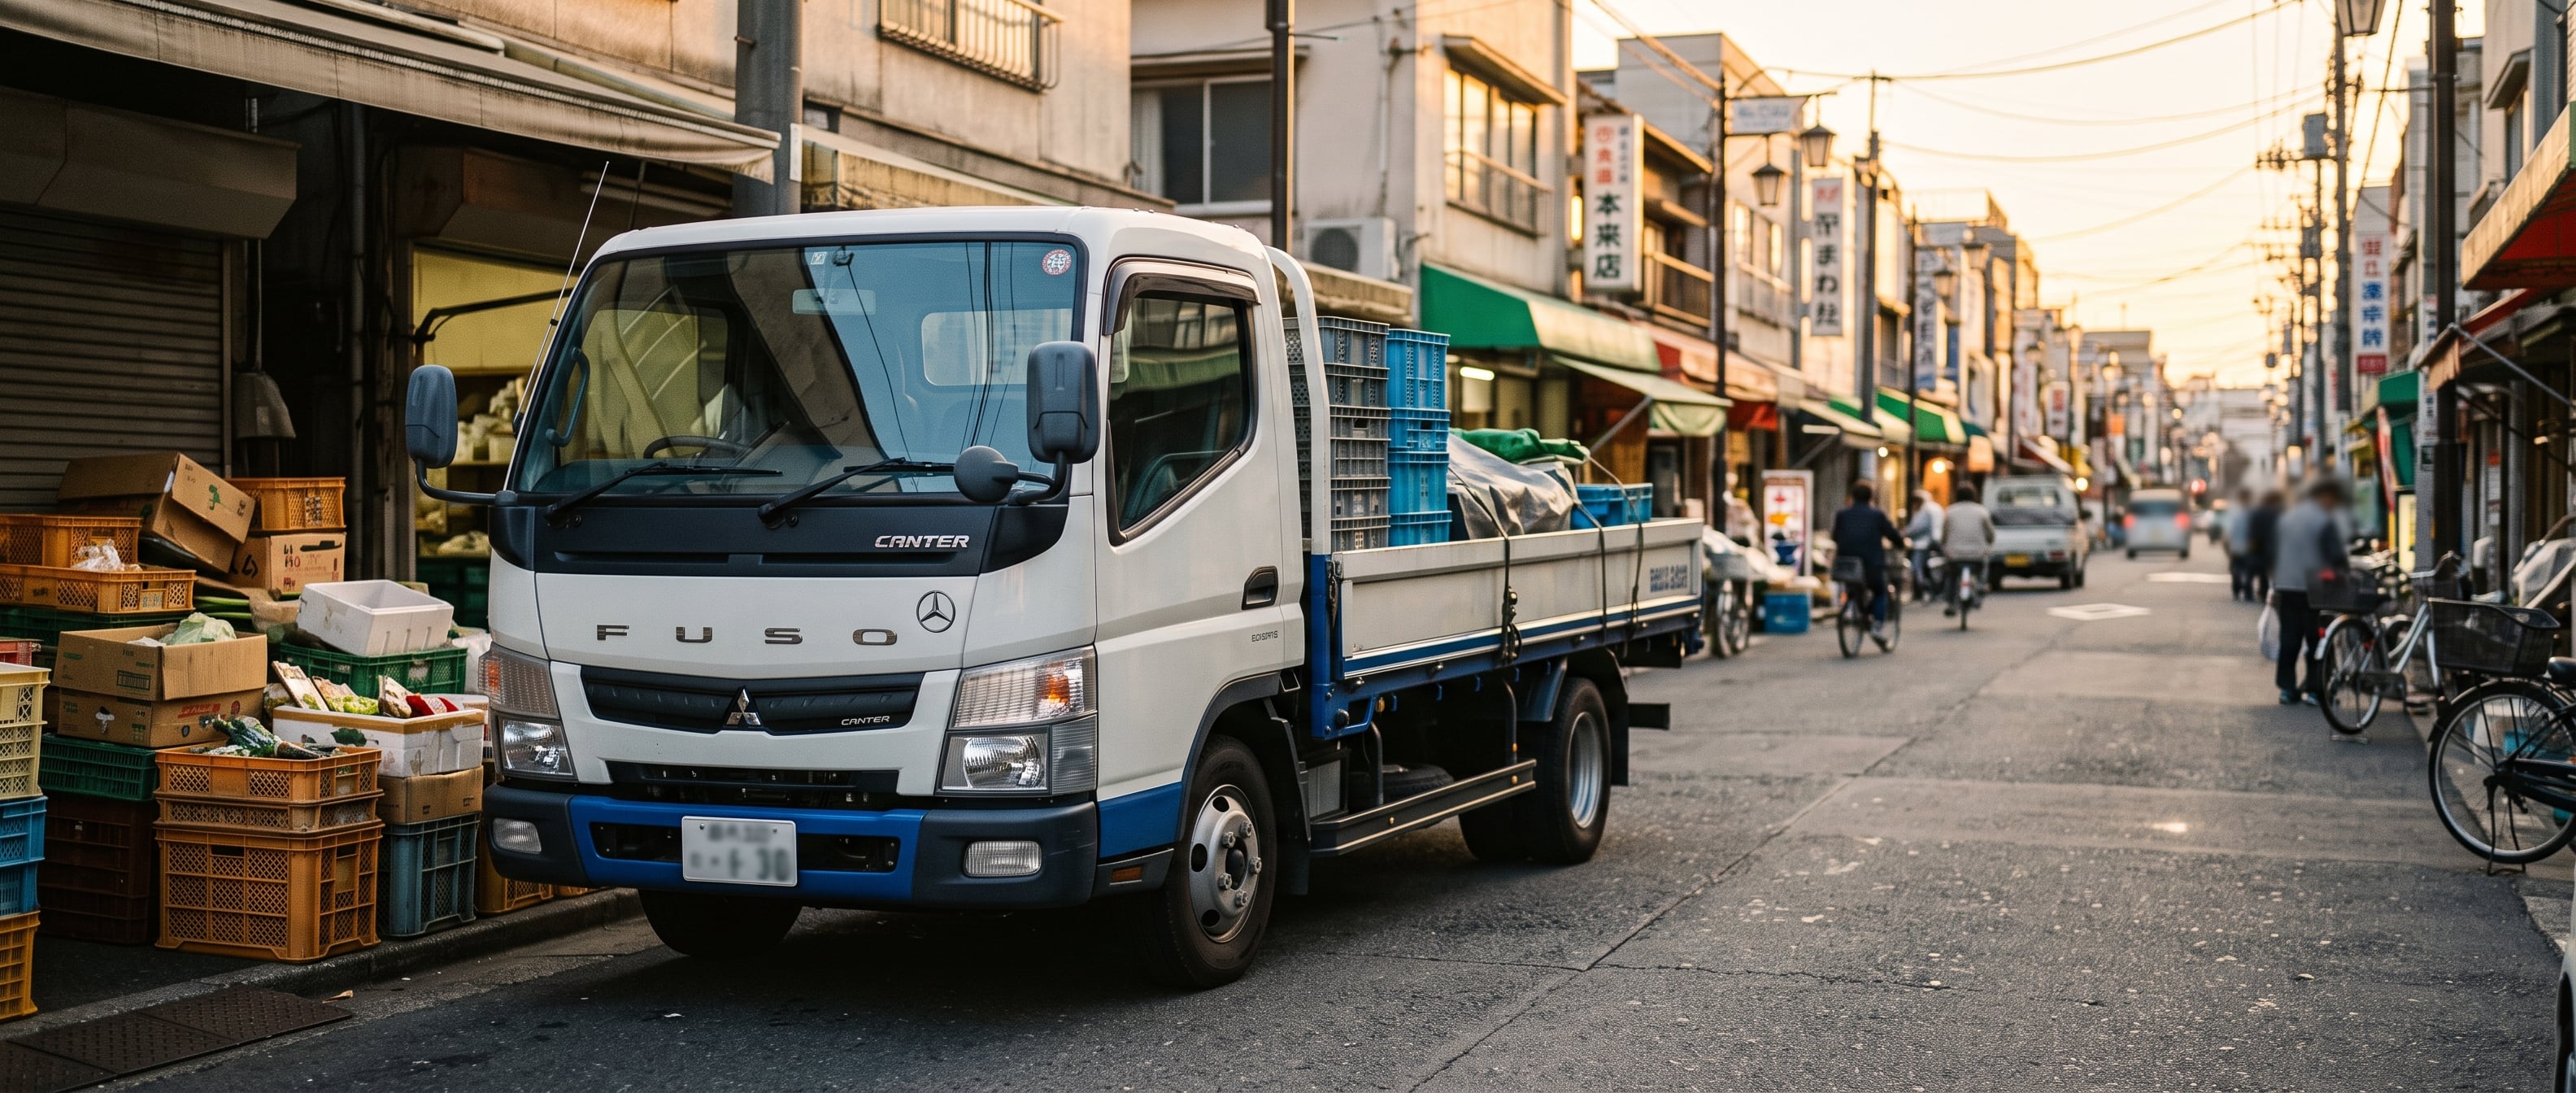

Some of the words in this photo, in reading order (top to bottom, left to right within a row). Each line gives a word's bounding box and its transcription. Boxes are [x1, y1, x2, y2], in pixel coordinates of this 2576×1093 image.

[874, 534, 970, 549] CANTER
[597, 624, 898, 646] FUSO
[841, 715, 890, 725] CANTER
